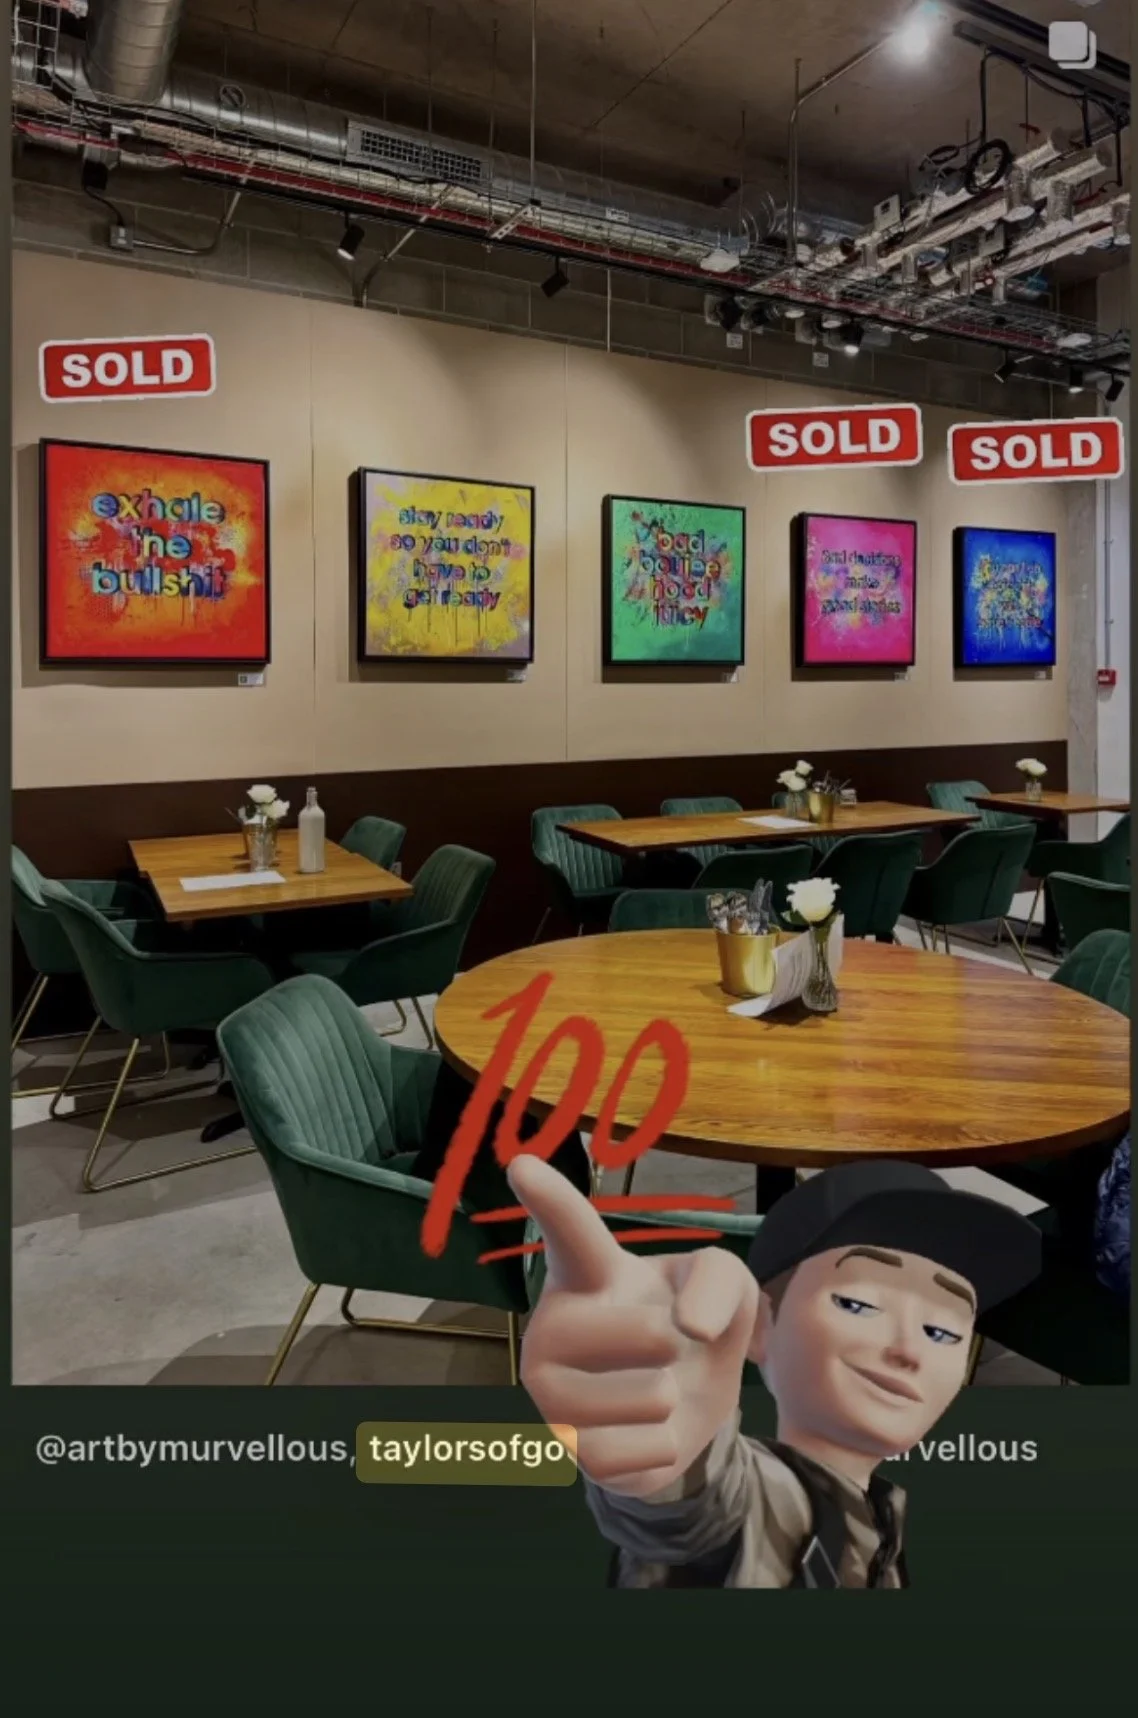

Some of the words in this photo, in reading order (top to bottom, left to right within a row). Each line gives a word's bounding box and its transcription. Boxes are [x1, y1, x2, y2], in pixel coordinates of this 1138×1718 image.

[91, 489, 225, 524] exhale
[446, 510, 504, 535] ready
[130, 525, 192, 560] the
[418, 536, 459, 555] you
[656, 526, 705, 554] bad
[91, 562, 227, 601] bullshit
[413, 558, 466, 581] have
[468, 561, 491, 581] to
[440, 587, 501, 611] ready
